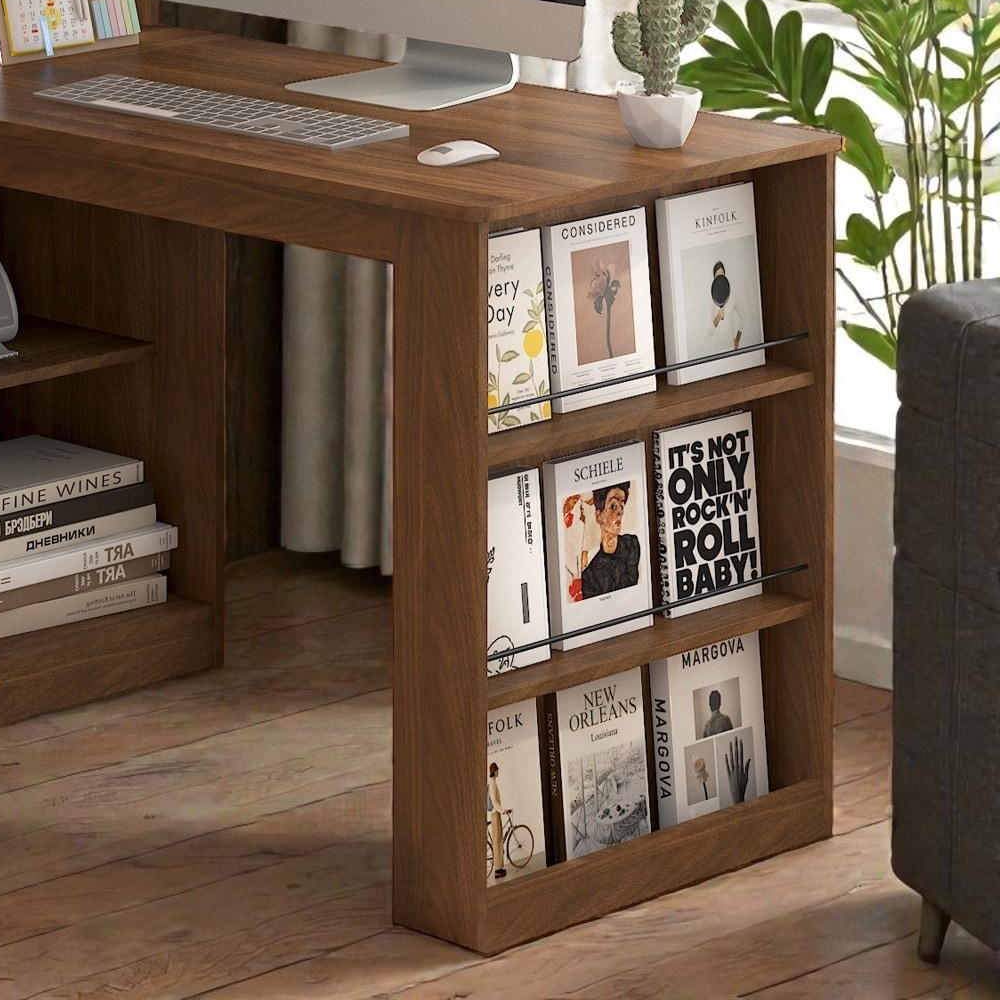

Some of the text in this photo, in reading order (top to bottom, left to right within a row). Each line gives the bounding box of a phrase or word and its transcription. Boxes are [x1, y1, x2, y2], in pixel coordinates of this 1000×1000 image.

[562, 215, 636, 240] CONSIDERED
[695, 211, 736, 228] KINFOLK
[491, 253, 510, 263] Darling
[497, 264, 514, 273] Thyme
[545, 266, 558, 375] CONSIDERED
[668, 430, 749, 469] IT'S NOT
[574, 457, 624, 482] SCHIELE
[668, 452, 750, 505] ONLY
[2, 489, 47, 511] FINE
[56, 471, 122, 497] WINES
[5, 510, 53, 536] БРЭДБЕРИ
[26, 526, 95, 552] ДНЕВНИКИ
[674, 514, 755, 569] ROLL
[676, 550, 758, 600] BABY!
[682, 637, 744, 669] MARGOVA
[584, 685, 616, 710] NEW
[488, 713, 523, 735] FOLK
[569, 697, 637, 732] ORLEANS
[547, 713, 555, 768] ORLEANS
[591, 729, 618, 742] Louisiana
[654, 699, 672, 799] MARGOVA
